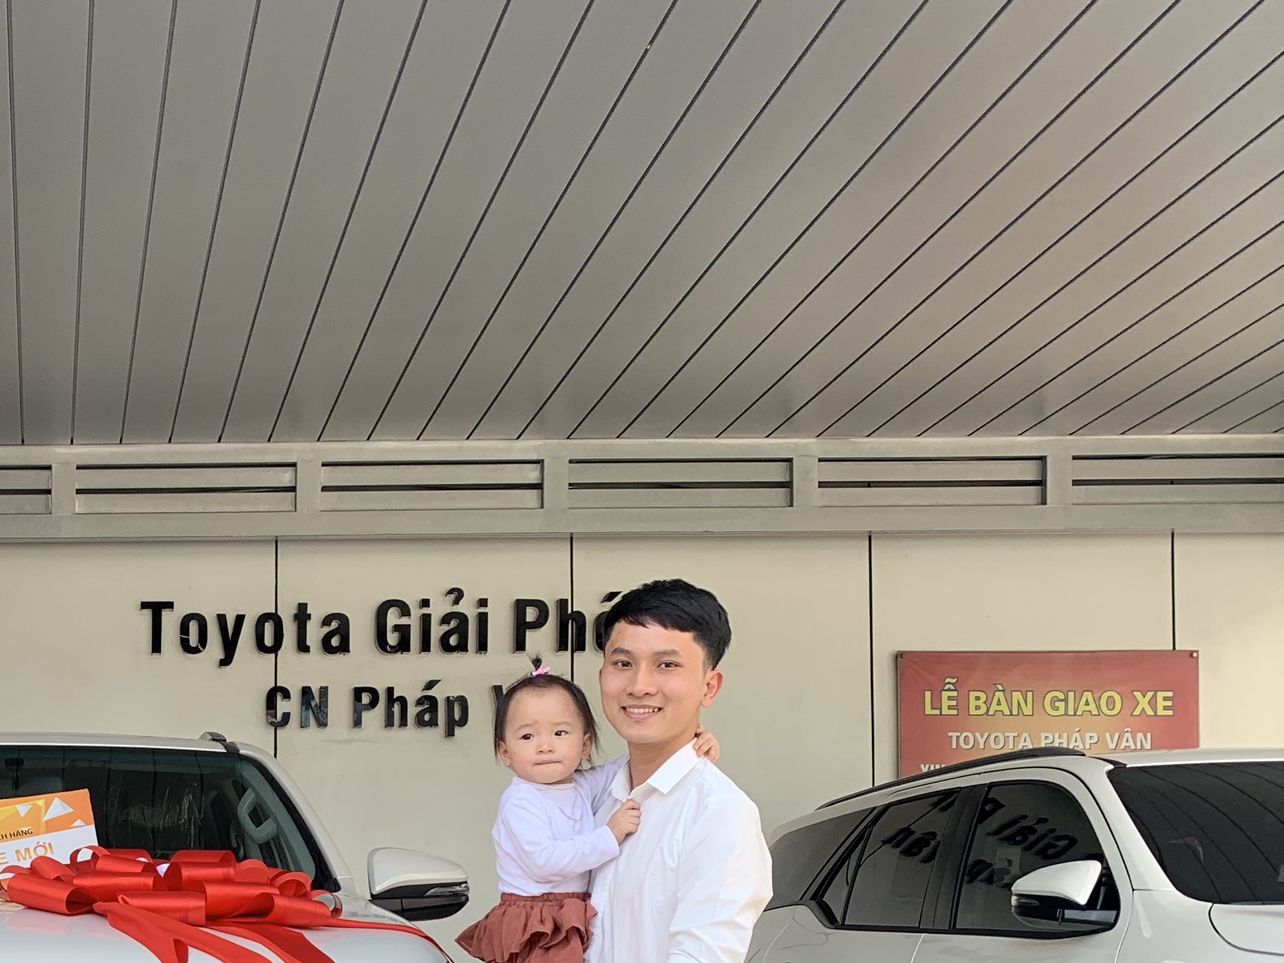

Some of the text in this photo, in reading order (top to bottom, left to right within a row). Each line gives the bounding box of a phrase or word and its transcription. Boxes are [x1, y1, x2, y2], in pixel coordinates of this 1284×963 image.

[140, 600, 351, 668] Toyota
[376, 587, 490, 655] Giải
[266, 685, 329, 728] CN
[353, 679, 469, 738] Pháp
[923, 677, 1175, 717] LỄ BÀN GIAO XE
[948, 728, 1152, 750] TOYOTA PHÁP VÂN
[15, 841, 55, 862] MỚI
